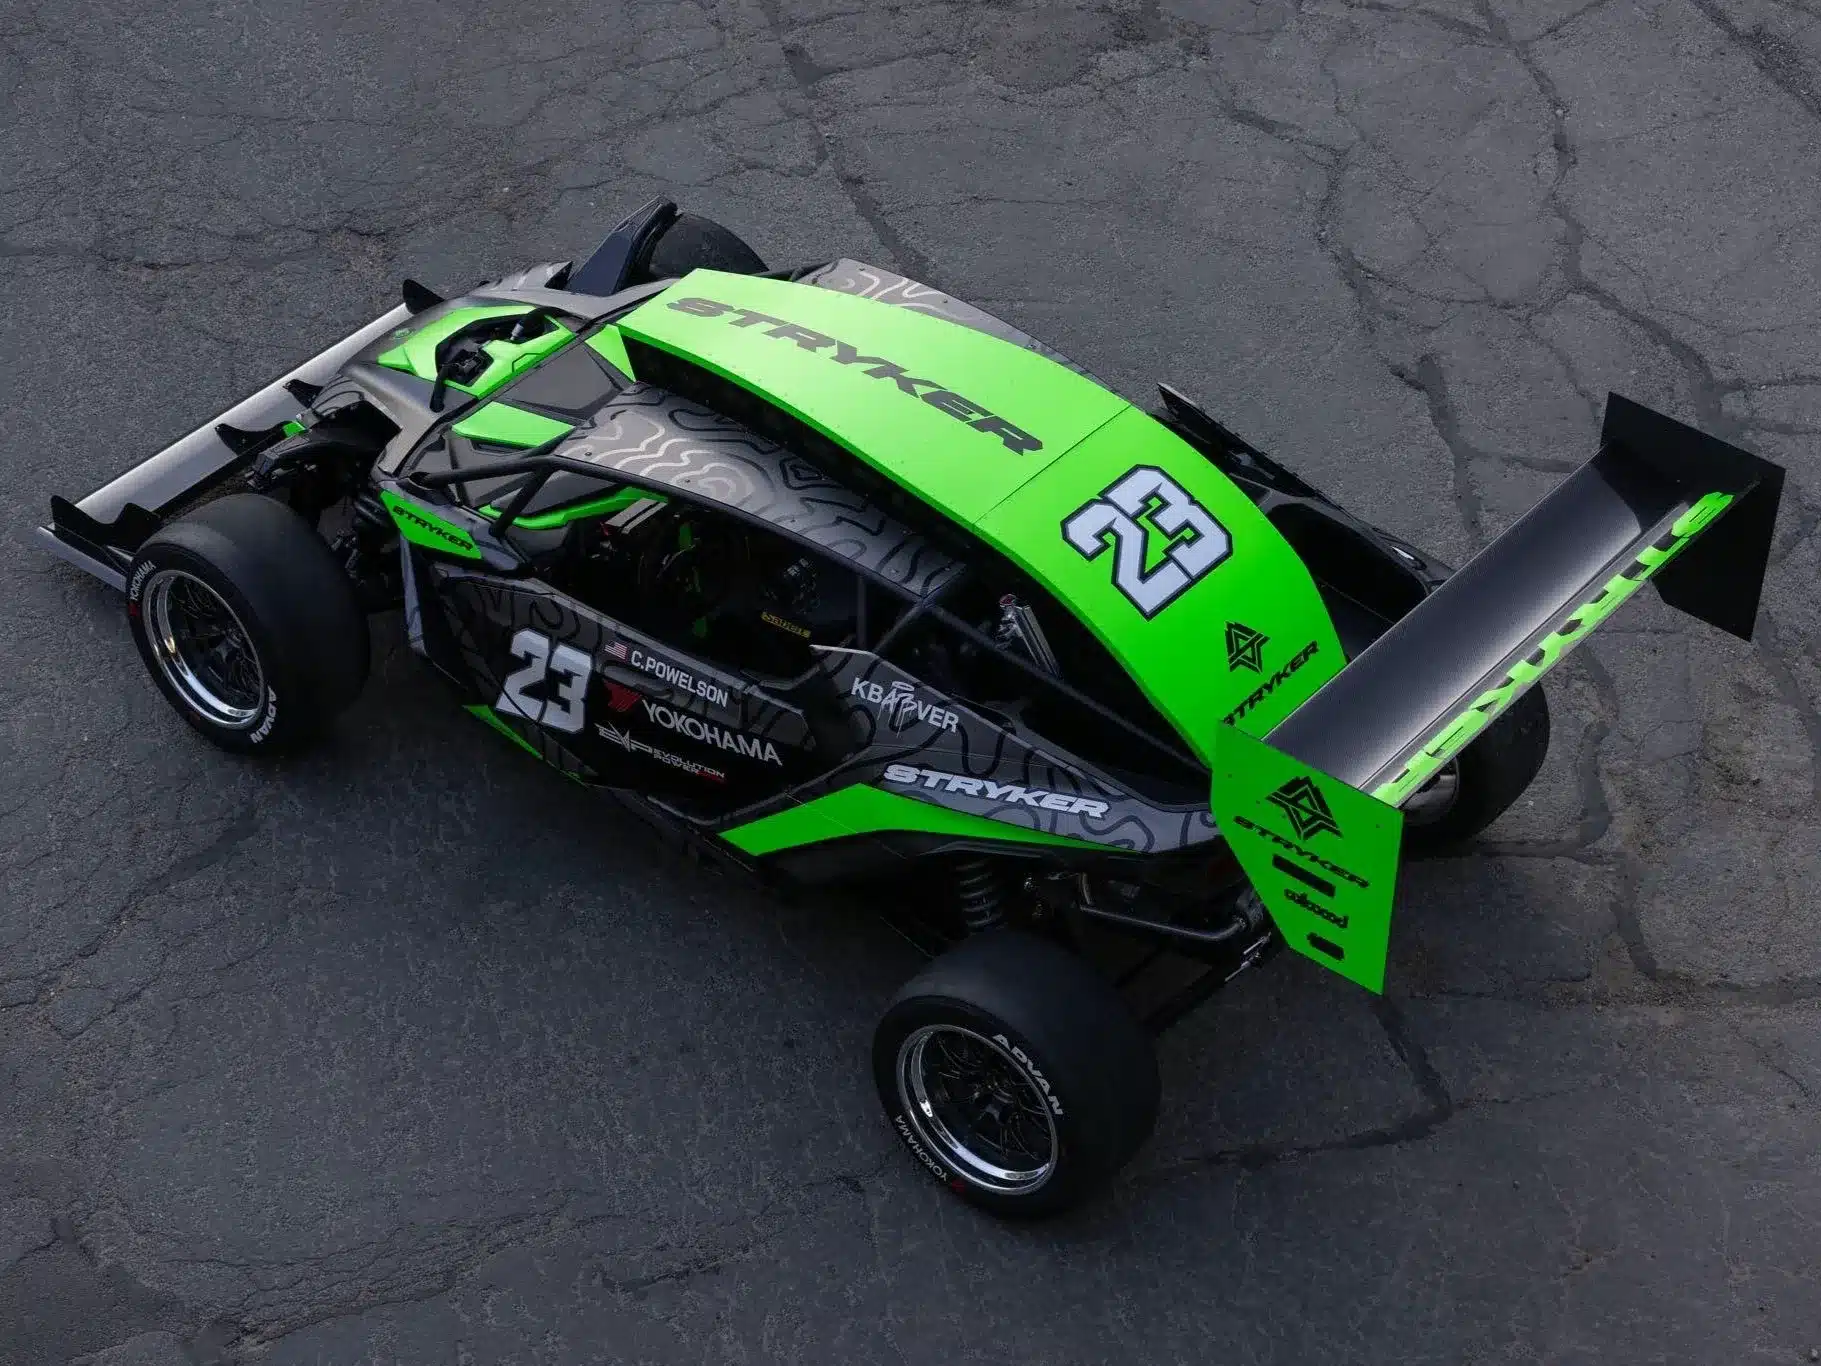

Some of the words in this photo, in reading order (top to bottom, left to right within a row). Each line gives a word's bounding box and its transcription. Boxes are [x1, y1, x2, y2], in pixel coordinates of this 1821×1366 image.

[666, 297, 1043, 456] STRYKER
[392, 504, 474, 552] STRYKER
[1060, 463, 1234, 623] 23
[129, 559, 157, 601] YOKOHAMA
[249, 684, 278, 744] ADVAN
[495, 627, 592, 734] 23
[630, 649, 729, 709] C.POWELSON
[1222, 638, 1321, 727] STRYKER
[641, 698, 784, 768] YOKOHAMA
[652, 747, 726, 779] EVOLUTION
[883, 762, 1111, 820] STRYKER
[1232, 814, 1371, 889] STRYKER
[991, 1033, 1065, 1116] ADVAN
[894, 1113, 948, 1183] YOKOHAMA
